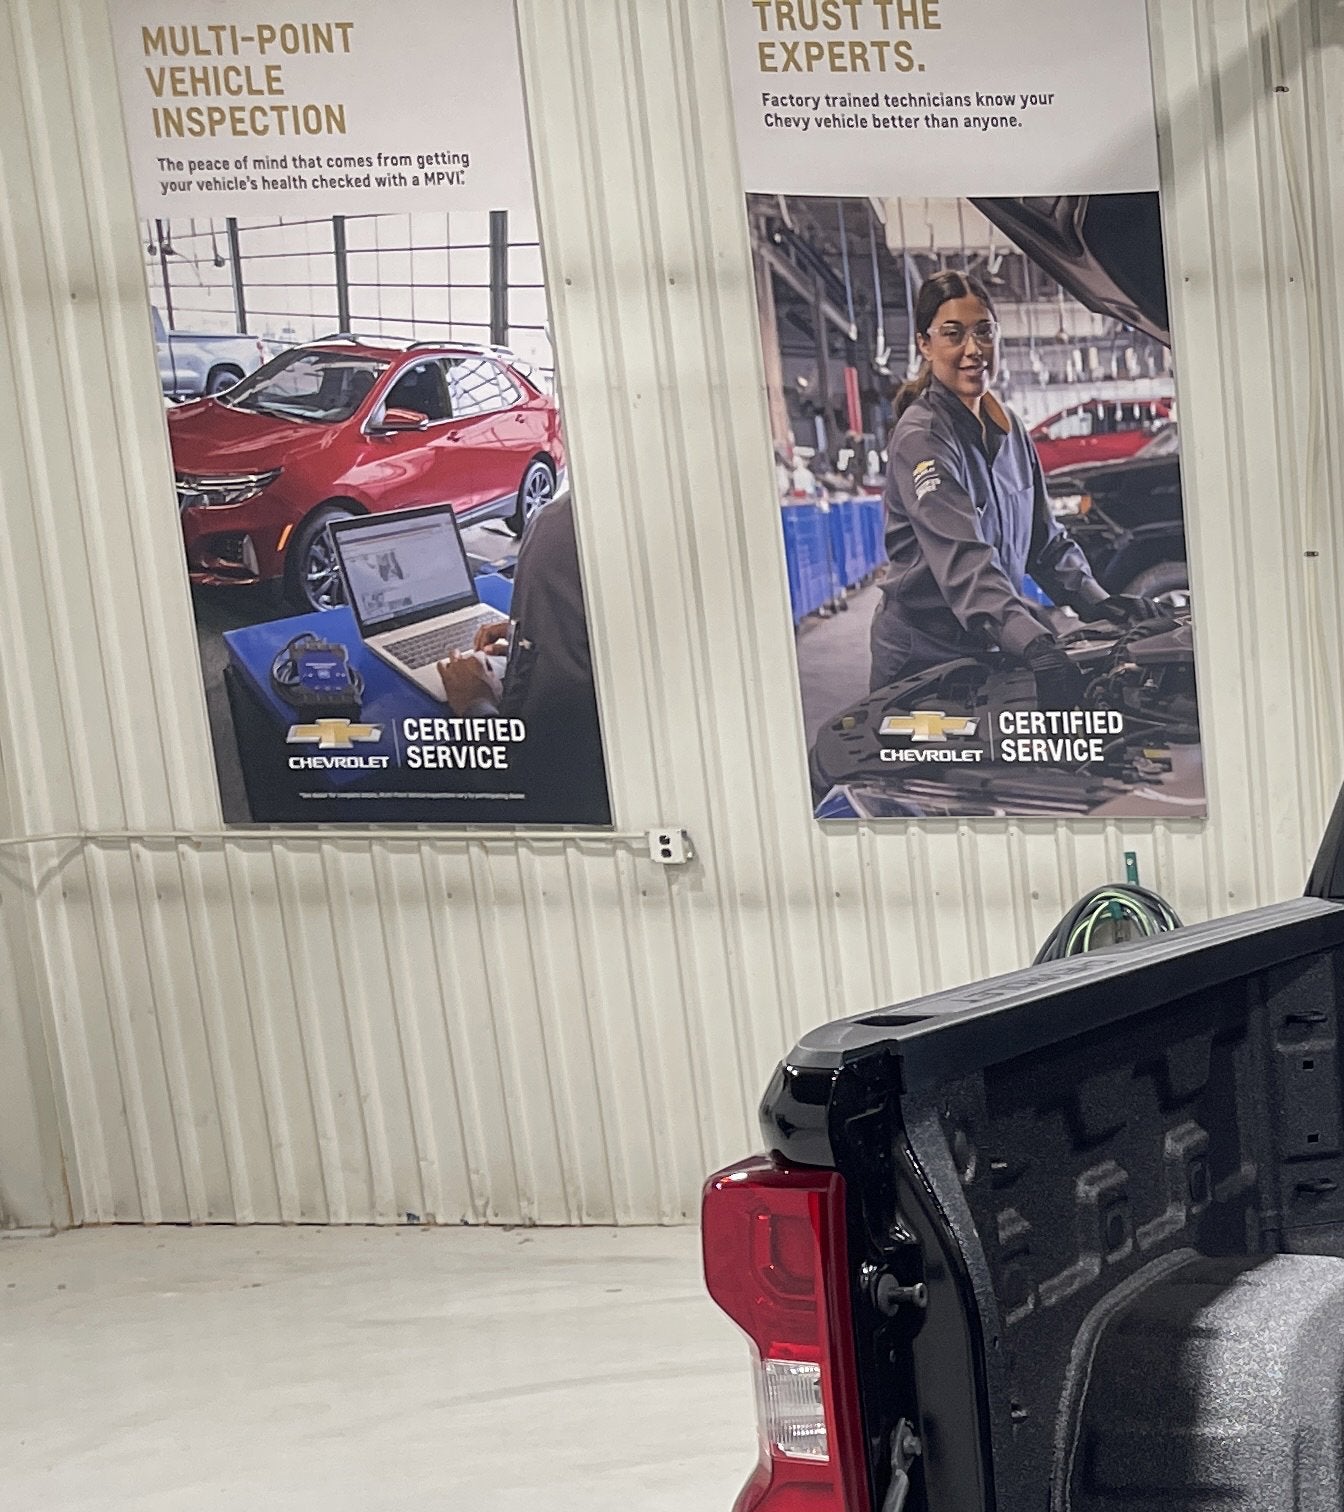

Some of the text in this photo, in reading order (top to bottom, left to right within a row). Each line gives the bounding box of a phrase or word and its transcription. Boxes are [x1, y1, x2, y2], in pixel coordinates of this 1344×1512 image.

[752, 0, 942, 32] TRUST THE
[141, 22, 354, 57] MULTI-POINT
[758, 40, 926, 73] EXPERTS.
[145, 64, 285, 97] VEHICLE
[761, 91, 1055, 110] Factory trained technicians know your
[152, 104, 347, 139] INSPECTION
[764, 112, 1023, 131] Chevy vehicle better than anyone.
[157, 150, 470, 175] The peace of mind that comes from getting
[160, 180, 193, 195] your
[196, 175, 258, 192] vehicle's
[261, 174, 308, 189] health
[311, 173, 371, 189] checked
[375, 172, 408, 187] with
[412, 174, 420, 186] a
[403, 717, 526, 742] CERTIFIED
[998, 710, 1124, 735] CERTIFIED
[288, 755, 390, 769] CHEVROLET
[407, 745, 509, 770] SERVICE
[879, 749, 984, 762] CHEVROLET
[1001, 738, 1105, 763] SERVICE
